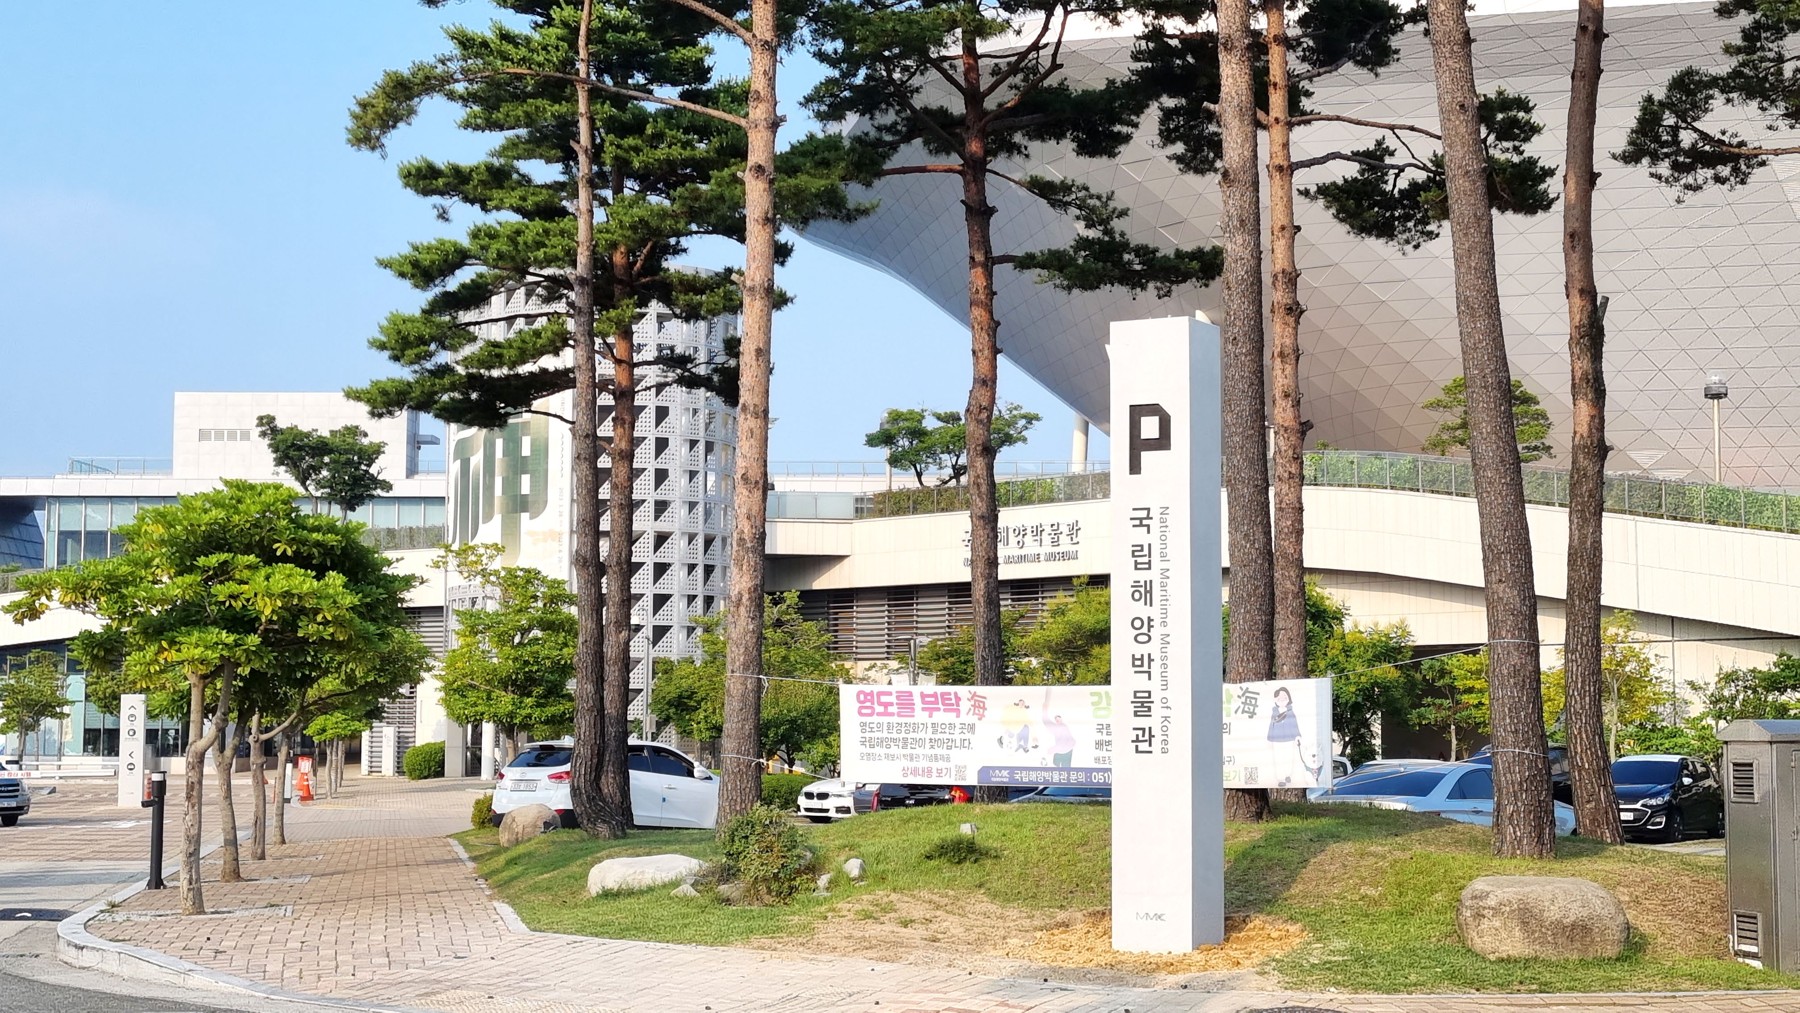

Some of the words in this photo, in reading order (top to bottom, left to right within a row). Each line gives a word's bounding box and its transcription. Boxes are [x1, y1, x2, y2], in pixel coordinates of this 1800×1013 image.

[1129, 403, 1171, 475] P
[1159, 506, 1171, 562] National
[1043, 549, 1079, 562] MUSEUM
[1159, 567, 1171, 628] Maritime
[1129, 507, 1156, 754] 국립해양박물관
[1160, 633, 1171, 691] Museum
[856, 689, 916, 718] 영도를
[919, 690, 962, 719] 부탁
[966, 689, 987, 721] 海
[1160, 697, 1172, 710] of
[1234, 685, 1260, 719] 海
[859, 721, 885, 735] 영도의
[886, 722, 929, 735] 환경정화가
[930, 722, 957, 735] 필요한
[958, 722, 976, 736] 곳에
[859, 736, 926, 750] 국립해양박물관이
[928, 738, 973, 750] 찾아갑니다.
[1160, 716, 1172, 754] Korea
[901, 766, 934, 779] 상세내용
[935, 767, 952, 779] 보기
[1013, 770, 1068, 783] 국립해양박물관
[1069, 771, 1086, 783] 문의
